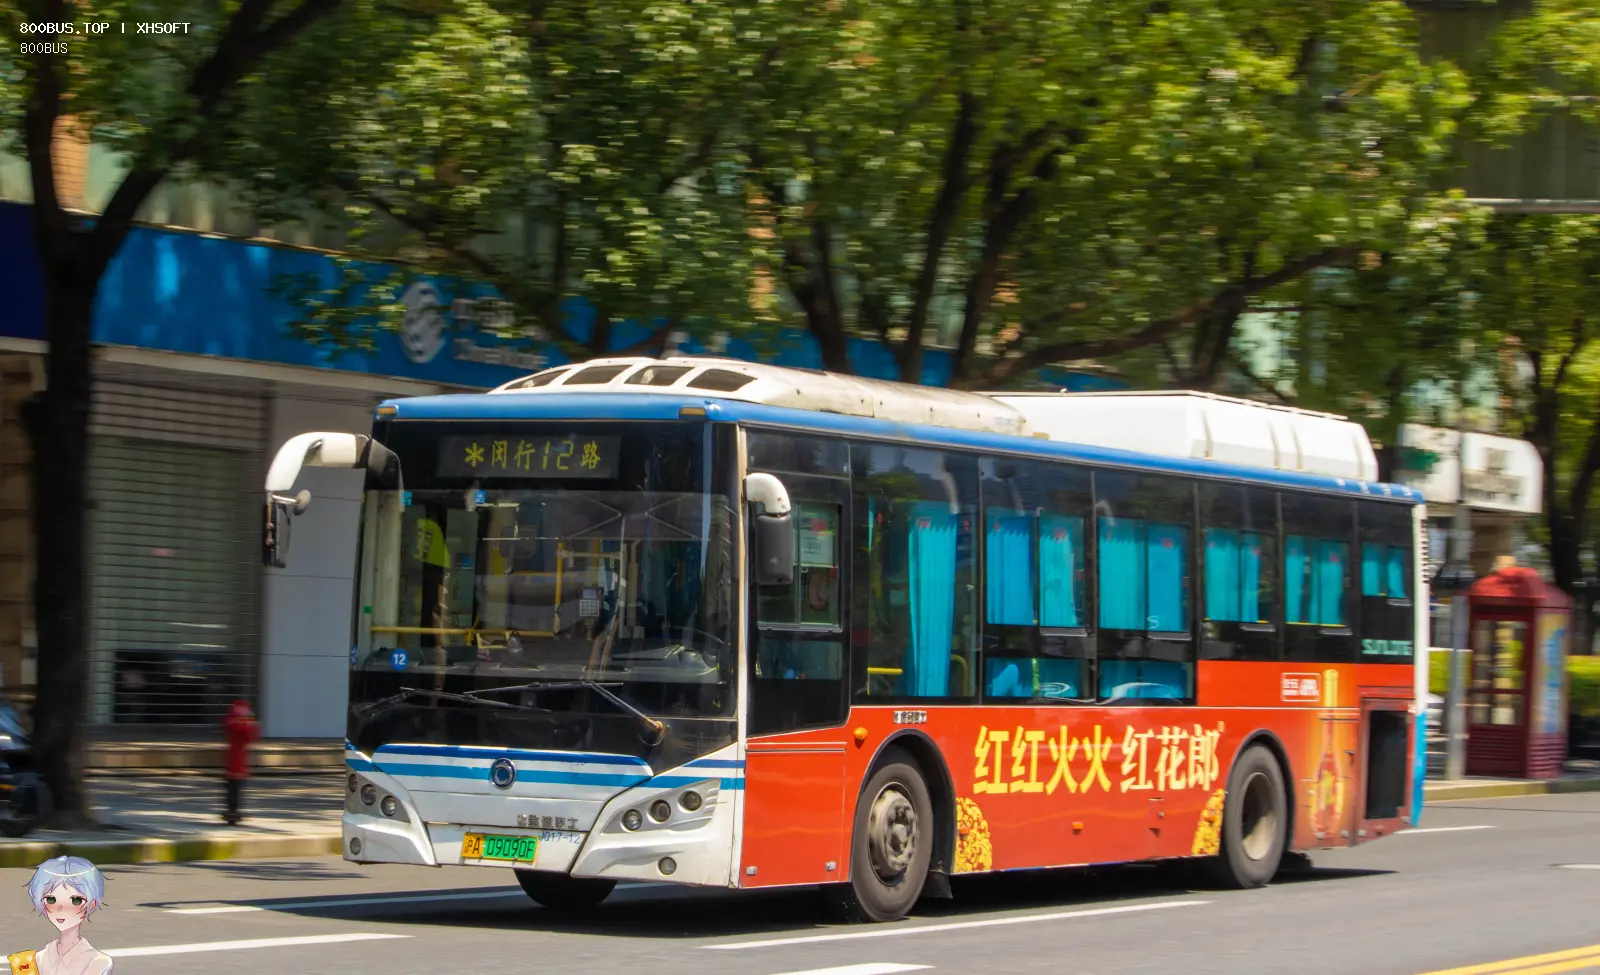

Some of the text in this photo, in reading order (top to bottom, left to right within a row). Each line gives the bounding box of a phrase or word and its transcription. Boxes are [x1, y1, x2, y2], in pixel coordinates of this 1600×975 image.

[393, 653, 407, 666] 12
[973, 723, 1221, 796] 红红火火 红花郎
